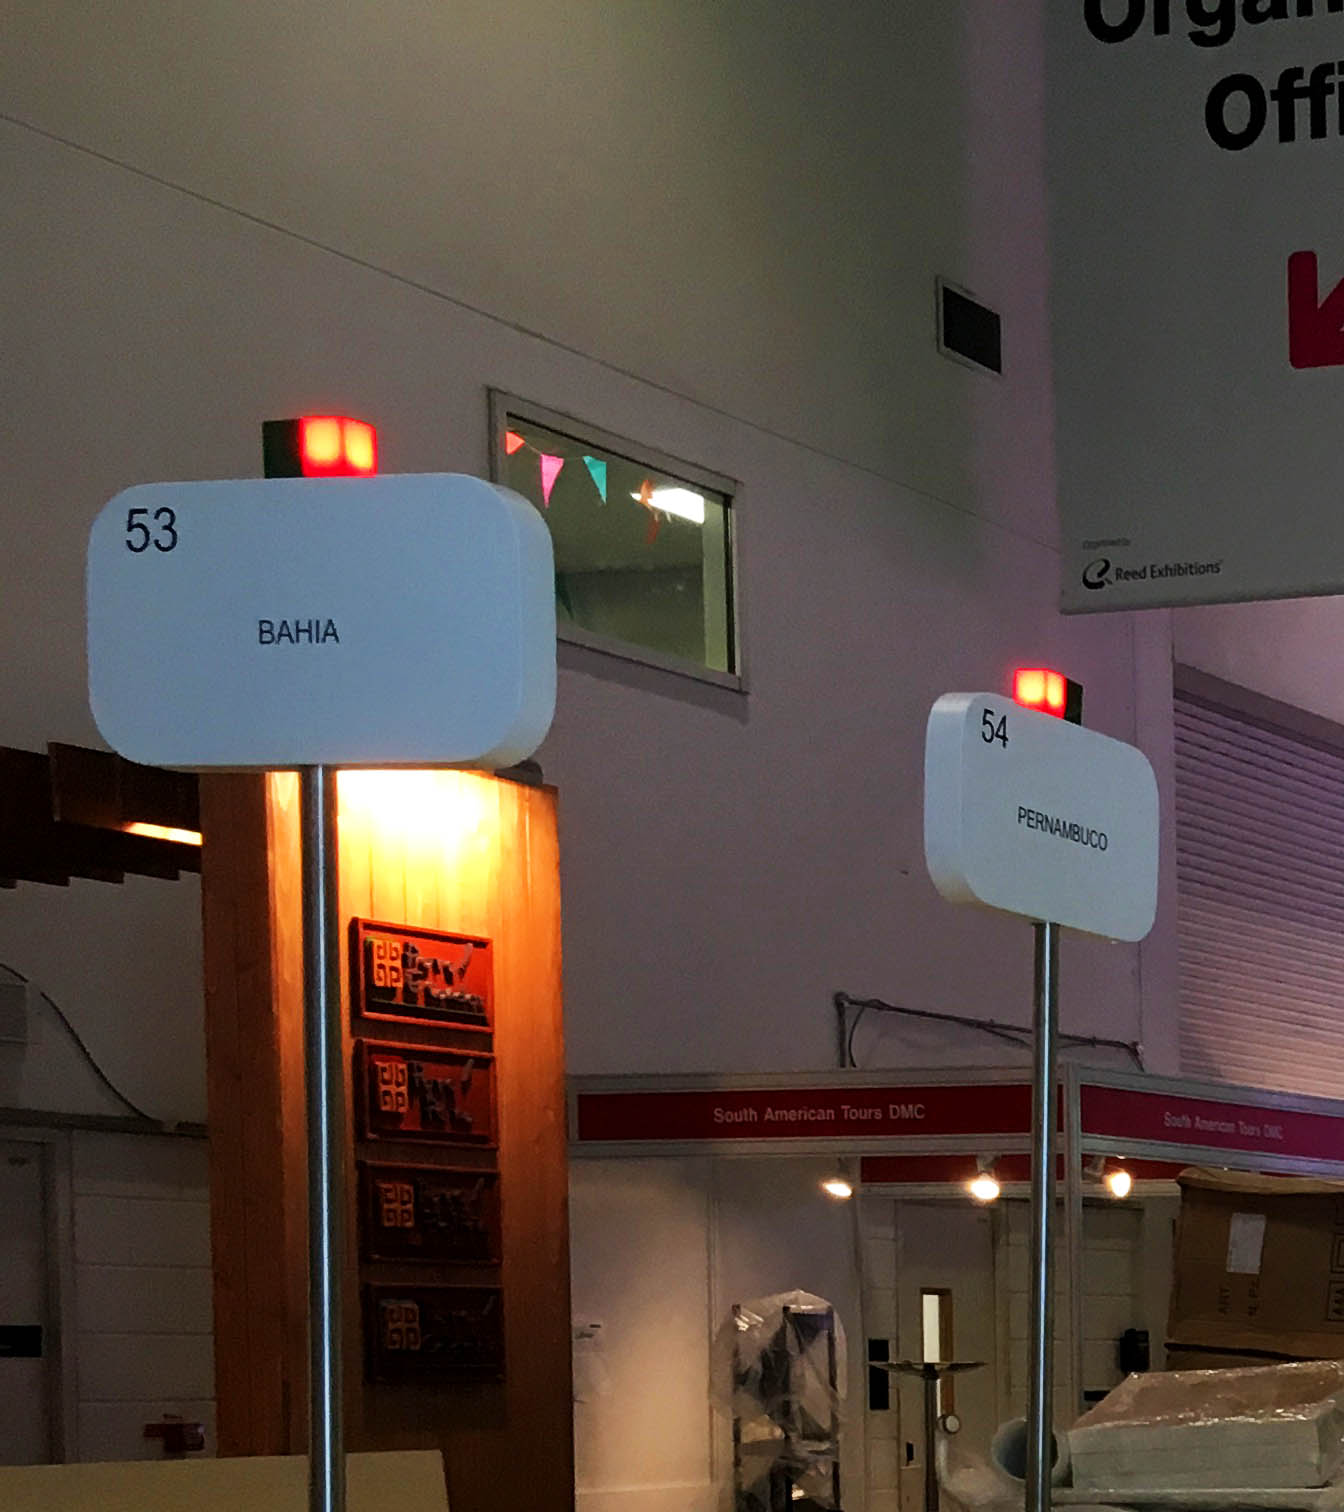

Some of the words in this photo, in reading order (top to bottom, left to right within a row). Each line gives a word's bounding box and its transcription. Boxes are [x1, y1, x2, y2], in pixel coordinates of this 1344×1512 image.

[125, 506, 178, 553] 53
[1115, 566, 1147, 582] Reed
[1150, 561, 1222, 581] Exhibitions
[258, 618, 340, 645] BAHIA
[981, 707, 1009, 749] 54
[1017, 806, 1108, 852] PERNAMBUCO
[713, 1107, 758, 1124] South
[763, 1106, 836, 1122] American
[841, 1104, 882, 1121] Tours
[888, 1104, 926, 1120] DMC
[1163, 1111, 1192, 1129] South
[1194, 1115, 1236, 1133] American
